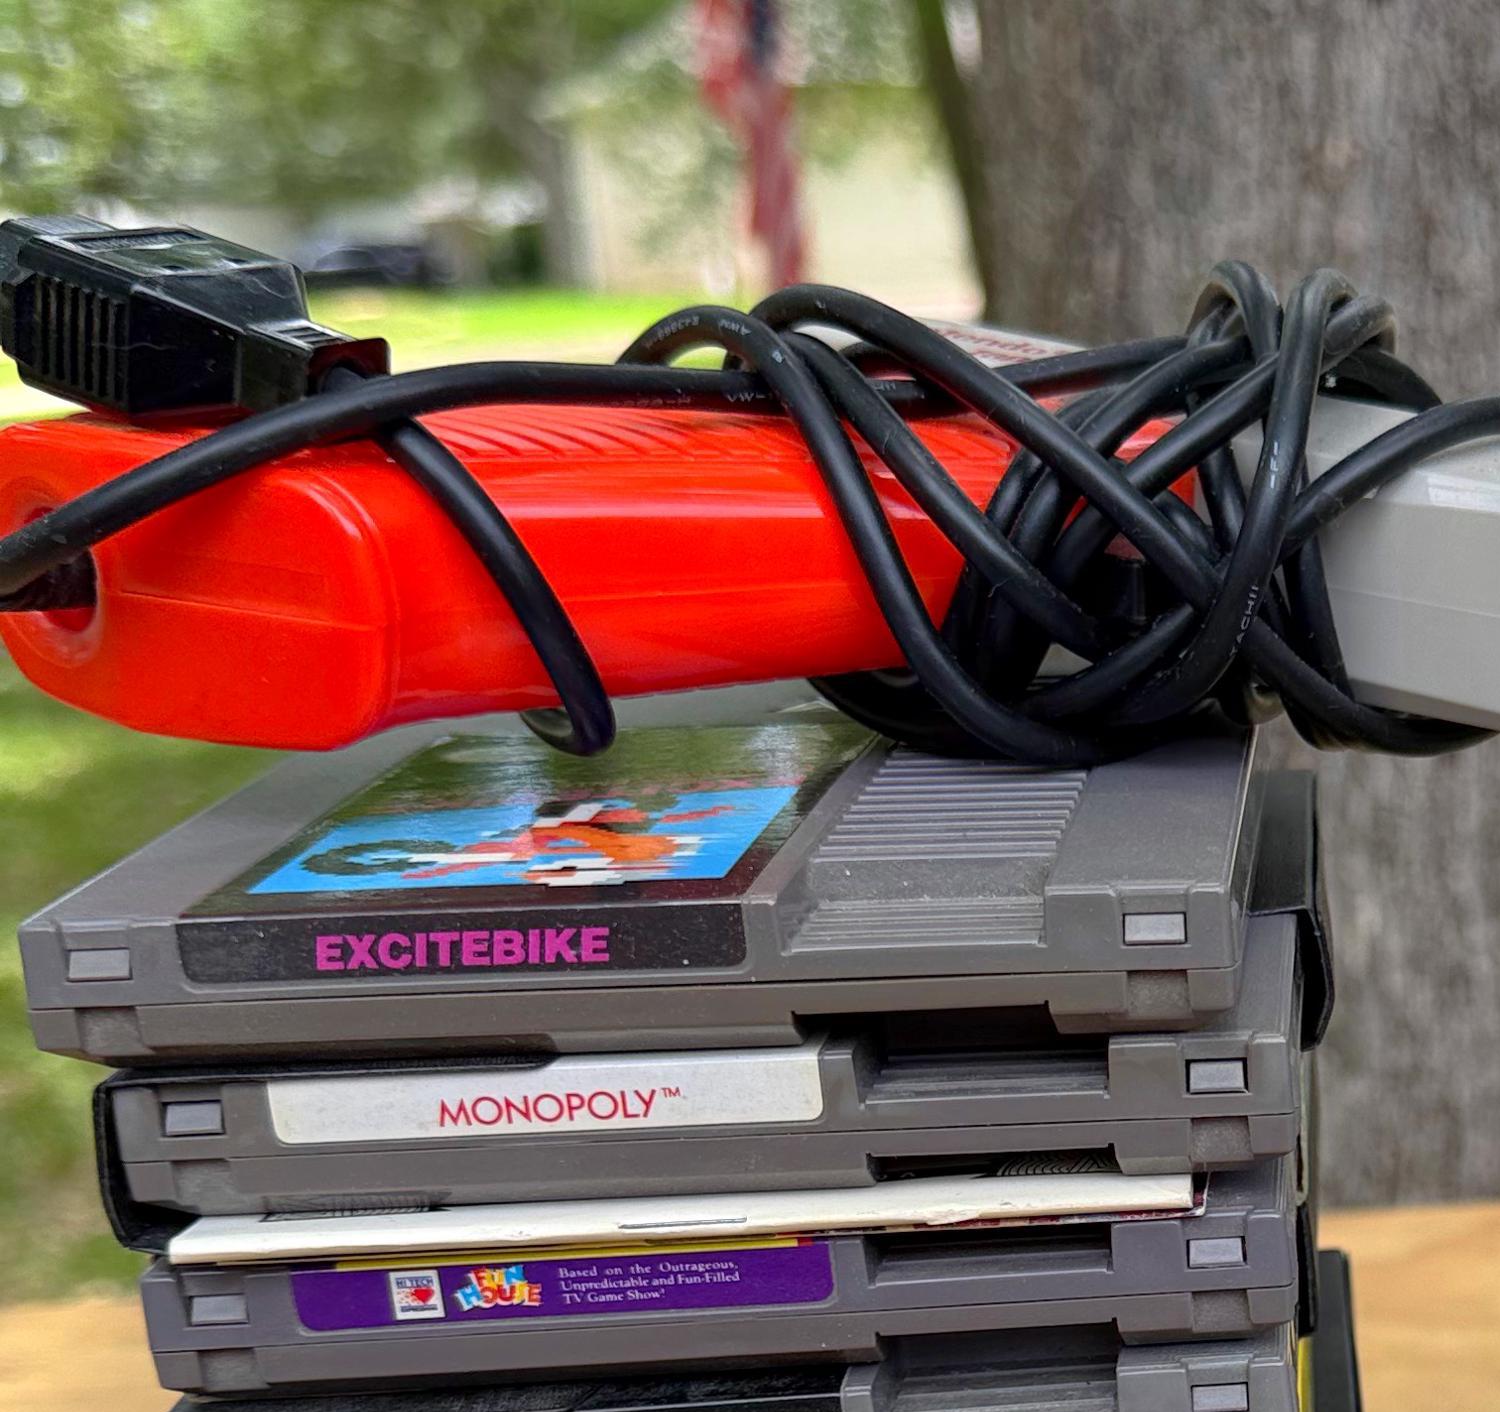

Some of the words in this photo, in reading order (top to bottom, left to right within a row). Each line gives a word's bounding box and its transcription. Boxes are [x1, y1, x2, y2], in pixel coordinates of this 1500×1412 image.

[315, 927, 610, 971] EXCITEBIKE
[469, 1264, 525, 1289] FUN
[559, 1266, 598, 1279] Based
[606, 1267, 623, 1276] on
[630, 1263, 652, 1275] the
[560, 1278, 650, 1293] Unpredictable
[652, 1275, 675, 1287] and
[678, 1272, 741, 1285] Fun-Filled
[562, 1292, 583, 1305] TV
[587, 1292, 623, 1304] Game
